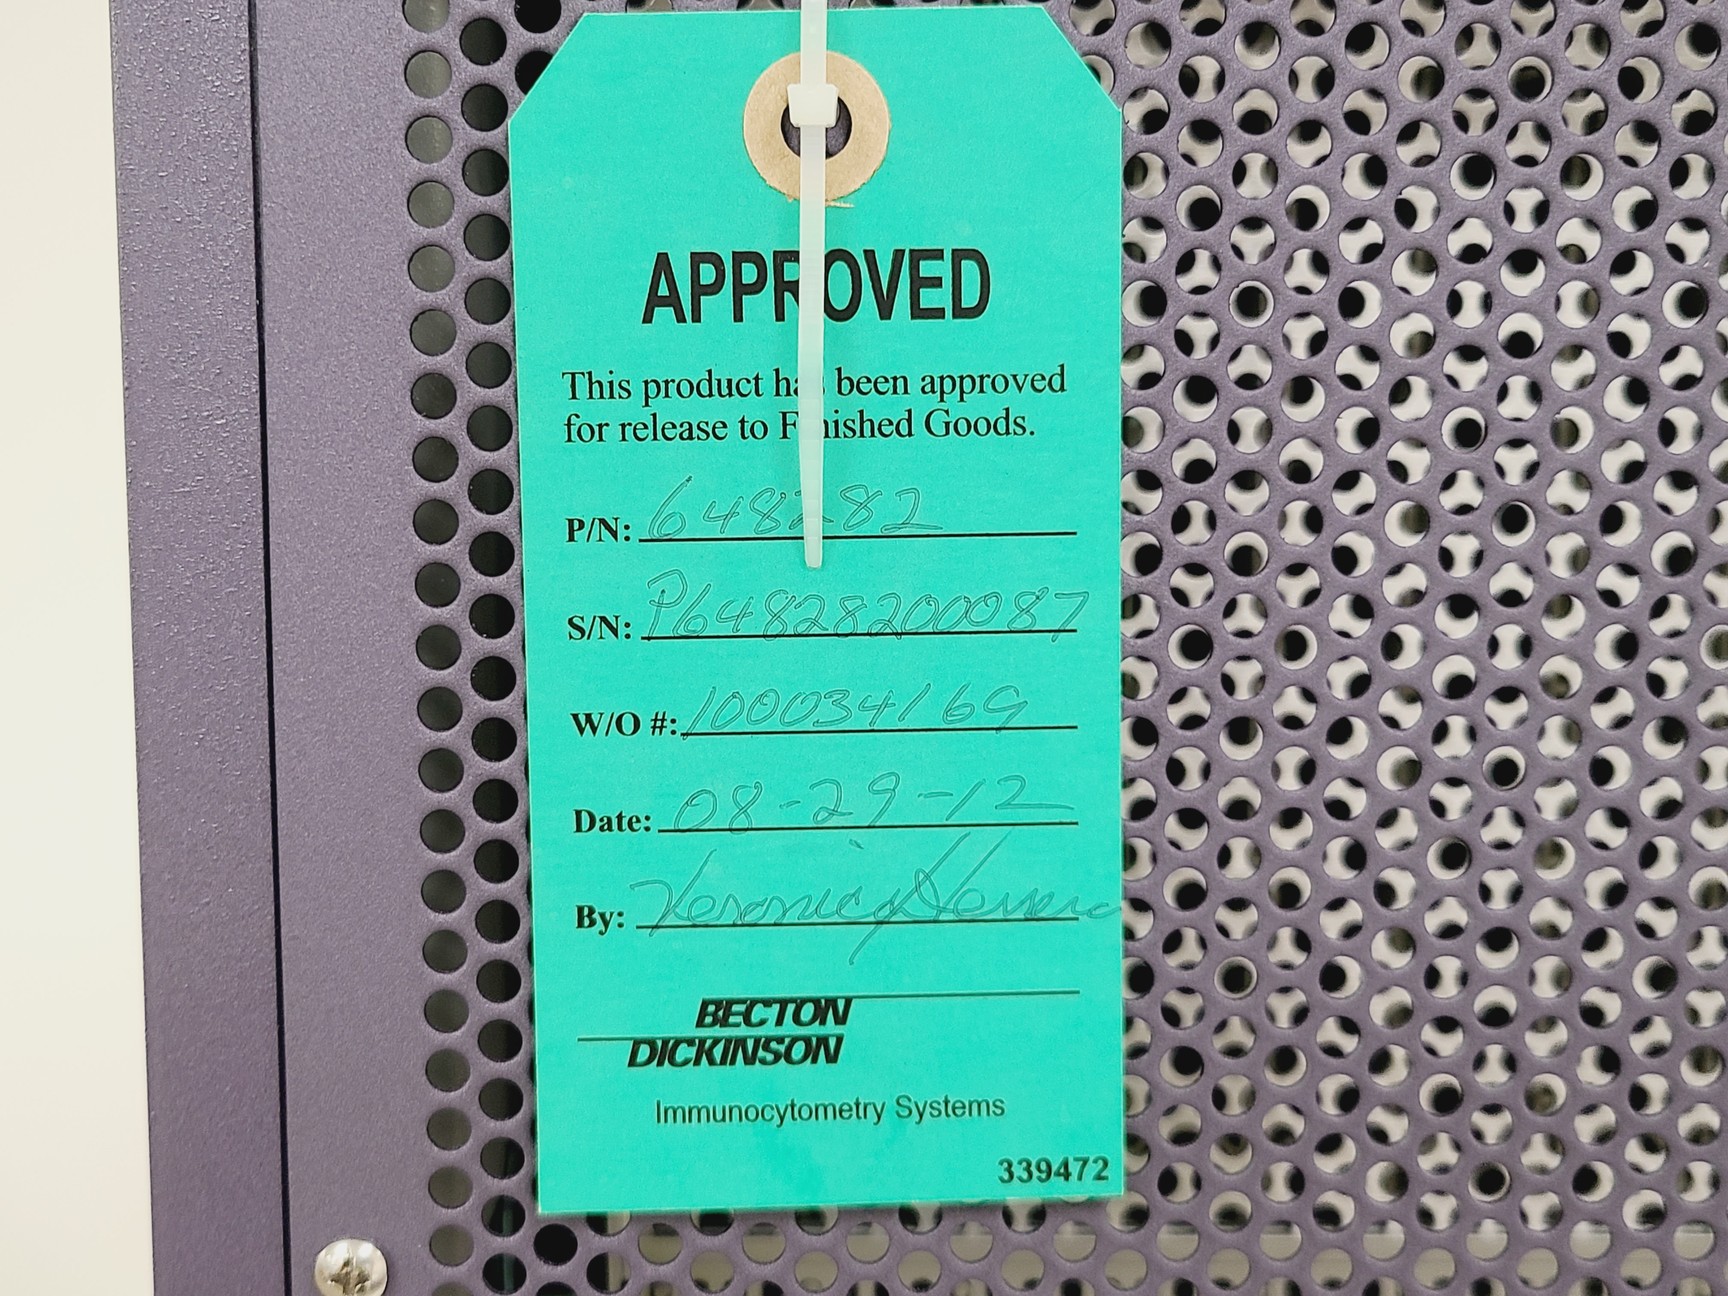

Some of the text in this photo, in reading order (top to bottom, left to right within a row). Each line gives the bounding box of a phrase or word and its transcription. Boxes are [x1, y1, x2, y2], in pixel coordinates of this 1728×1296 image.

[641, 248, 991, 325] APPROVED
[562, 370, 632, 401] This
[642, 367, 764, 407] product
[836, 366, 911, 397] been
[920, 363, 1067, 403] approved
[563, 407, 1036, 443] for release to Fished Goods.
[566, 517, 632, 543] P/N:
[647, 569, 1090, 643] P64828200087
[567, 615, 632, 641] S/N:
[570, 711, 678, 737] W/O #:
[573, 809, 652, 834] Date:
[575, 904, 625, 936] By:
[695, 998, 853, 1030] BECTON
[627, 1036, 844, 1068] DICKINSON
[655, 1094, 1006, 1129] Immunocytometry Systems
[997, 1156, 1110, 1184] 339472
